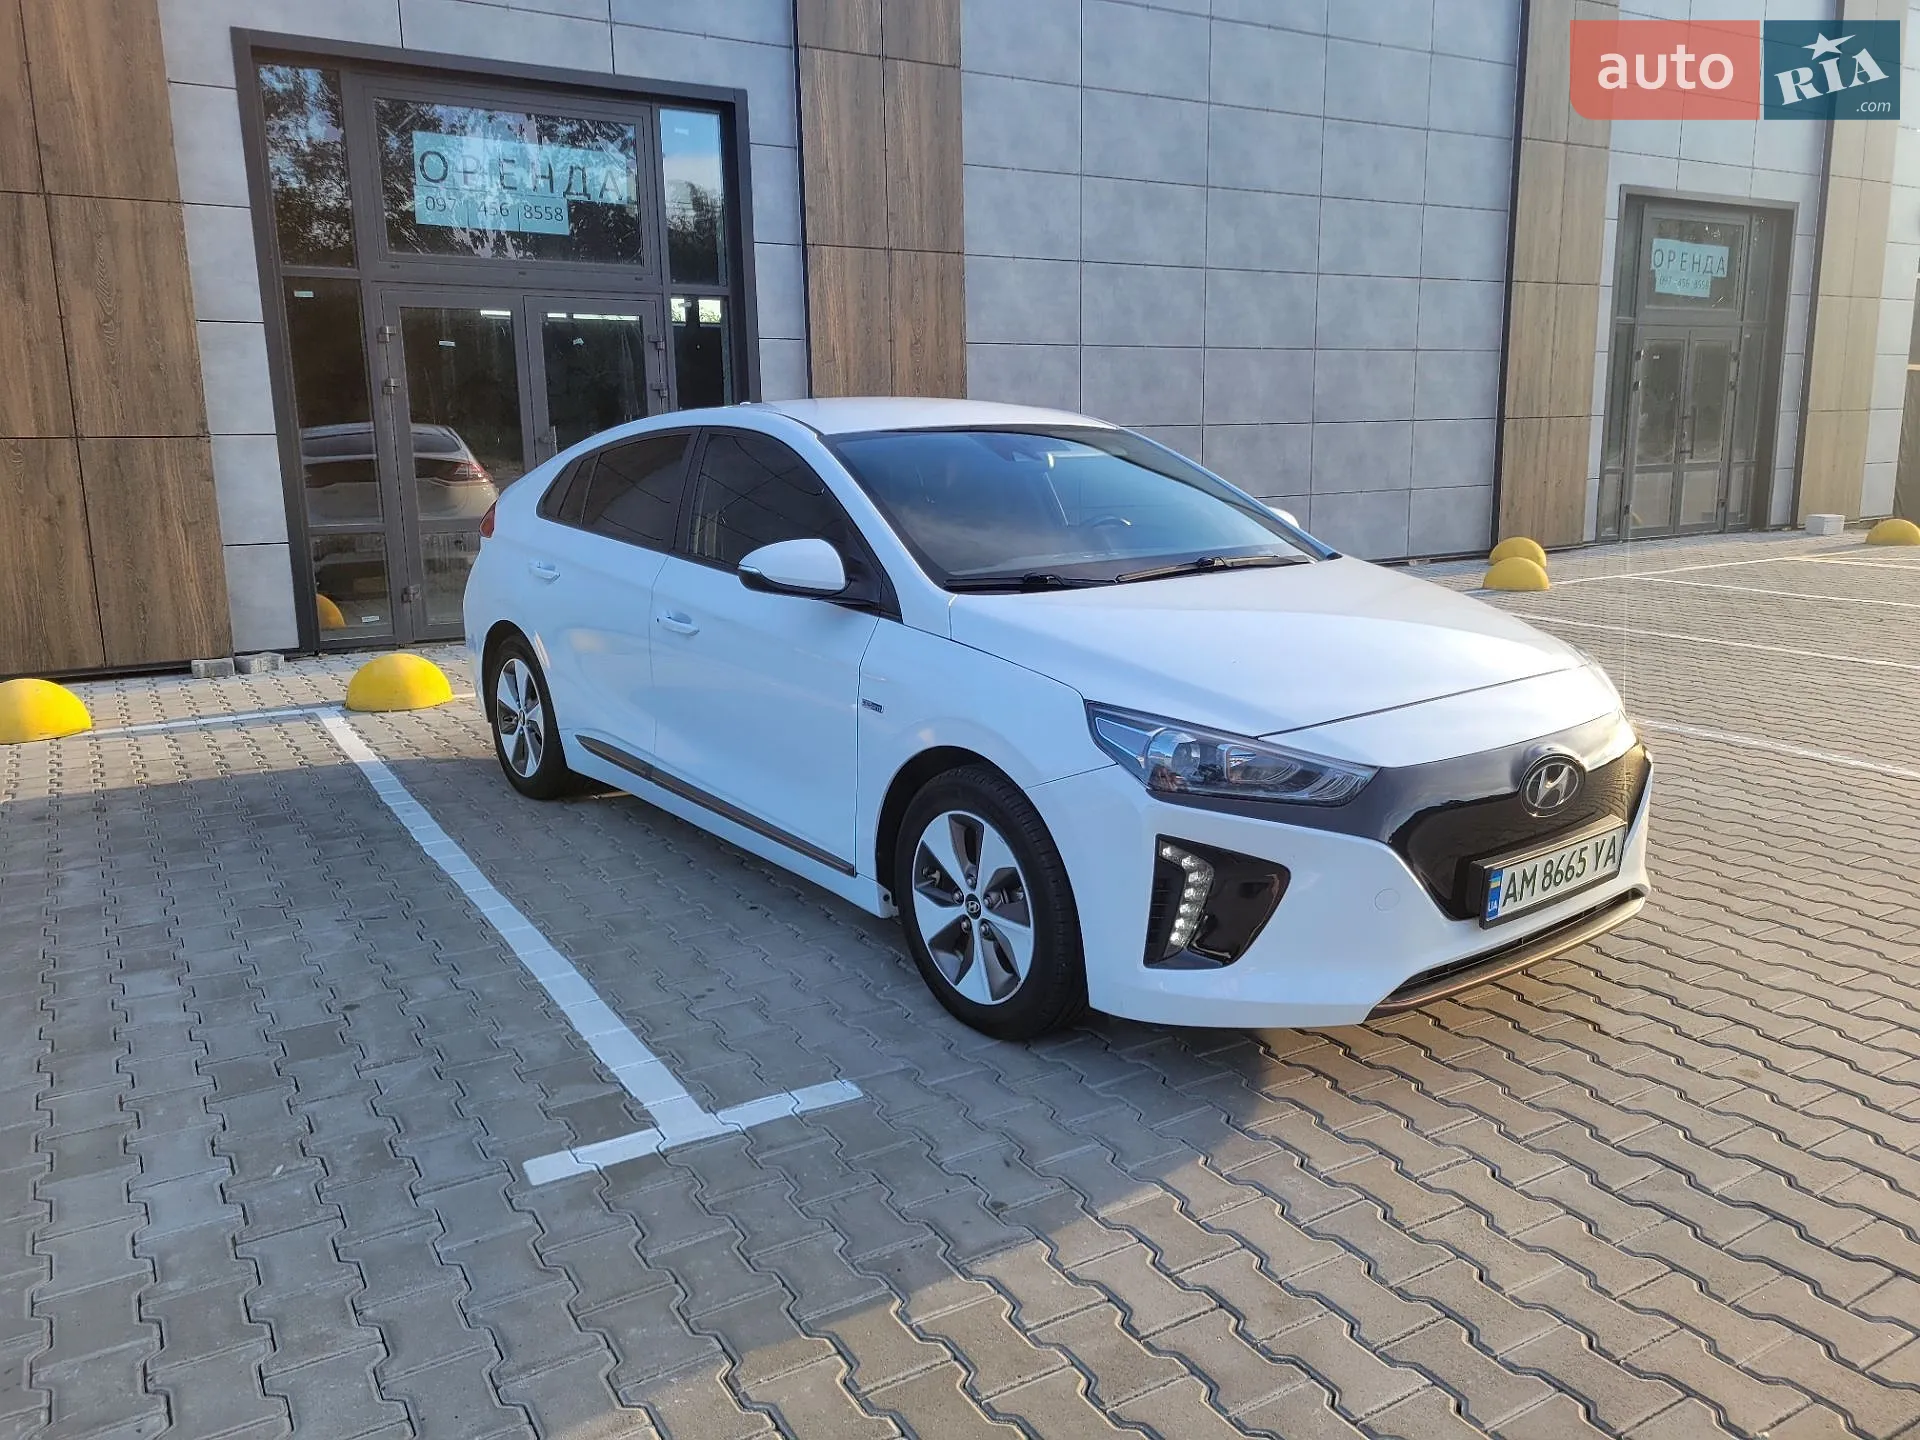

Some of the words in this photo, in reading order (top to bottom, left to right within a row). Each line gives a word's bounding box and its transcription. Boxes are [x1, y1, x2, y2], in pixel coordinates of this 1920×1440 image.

[419, 150, 623, 201] ОРЕНДА
[424, 194, 456, 213] 097
[477, 200, 510, 217] 456
[522, 204, 564, 222] 8558
[1653, 248, 1726, 275] ОРЕНДА
[1502, 864, 1538, 907] AM
[1541, 846, 1588, 891] 8665
[1594, 835, 1616, 871] YA
